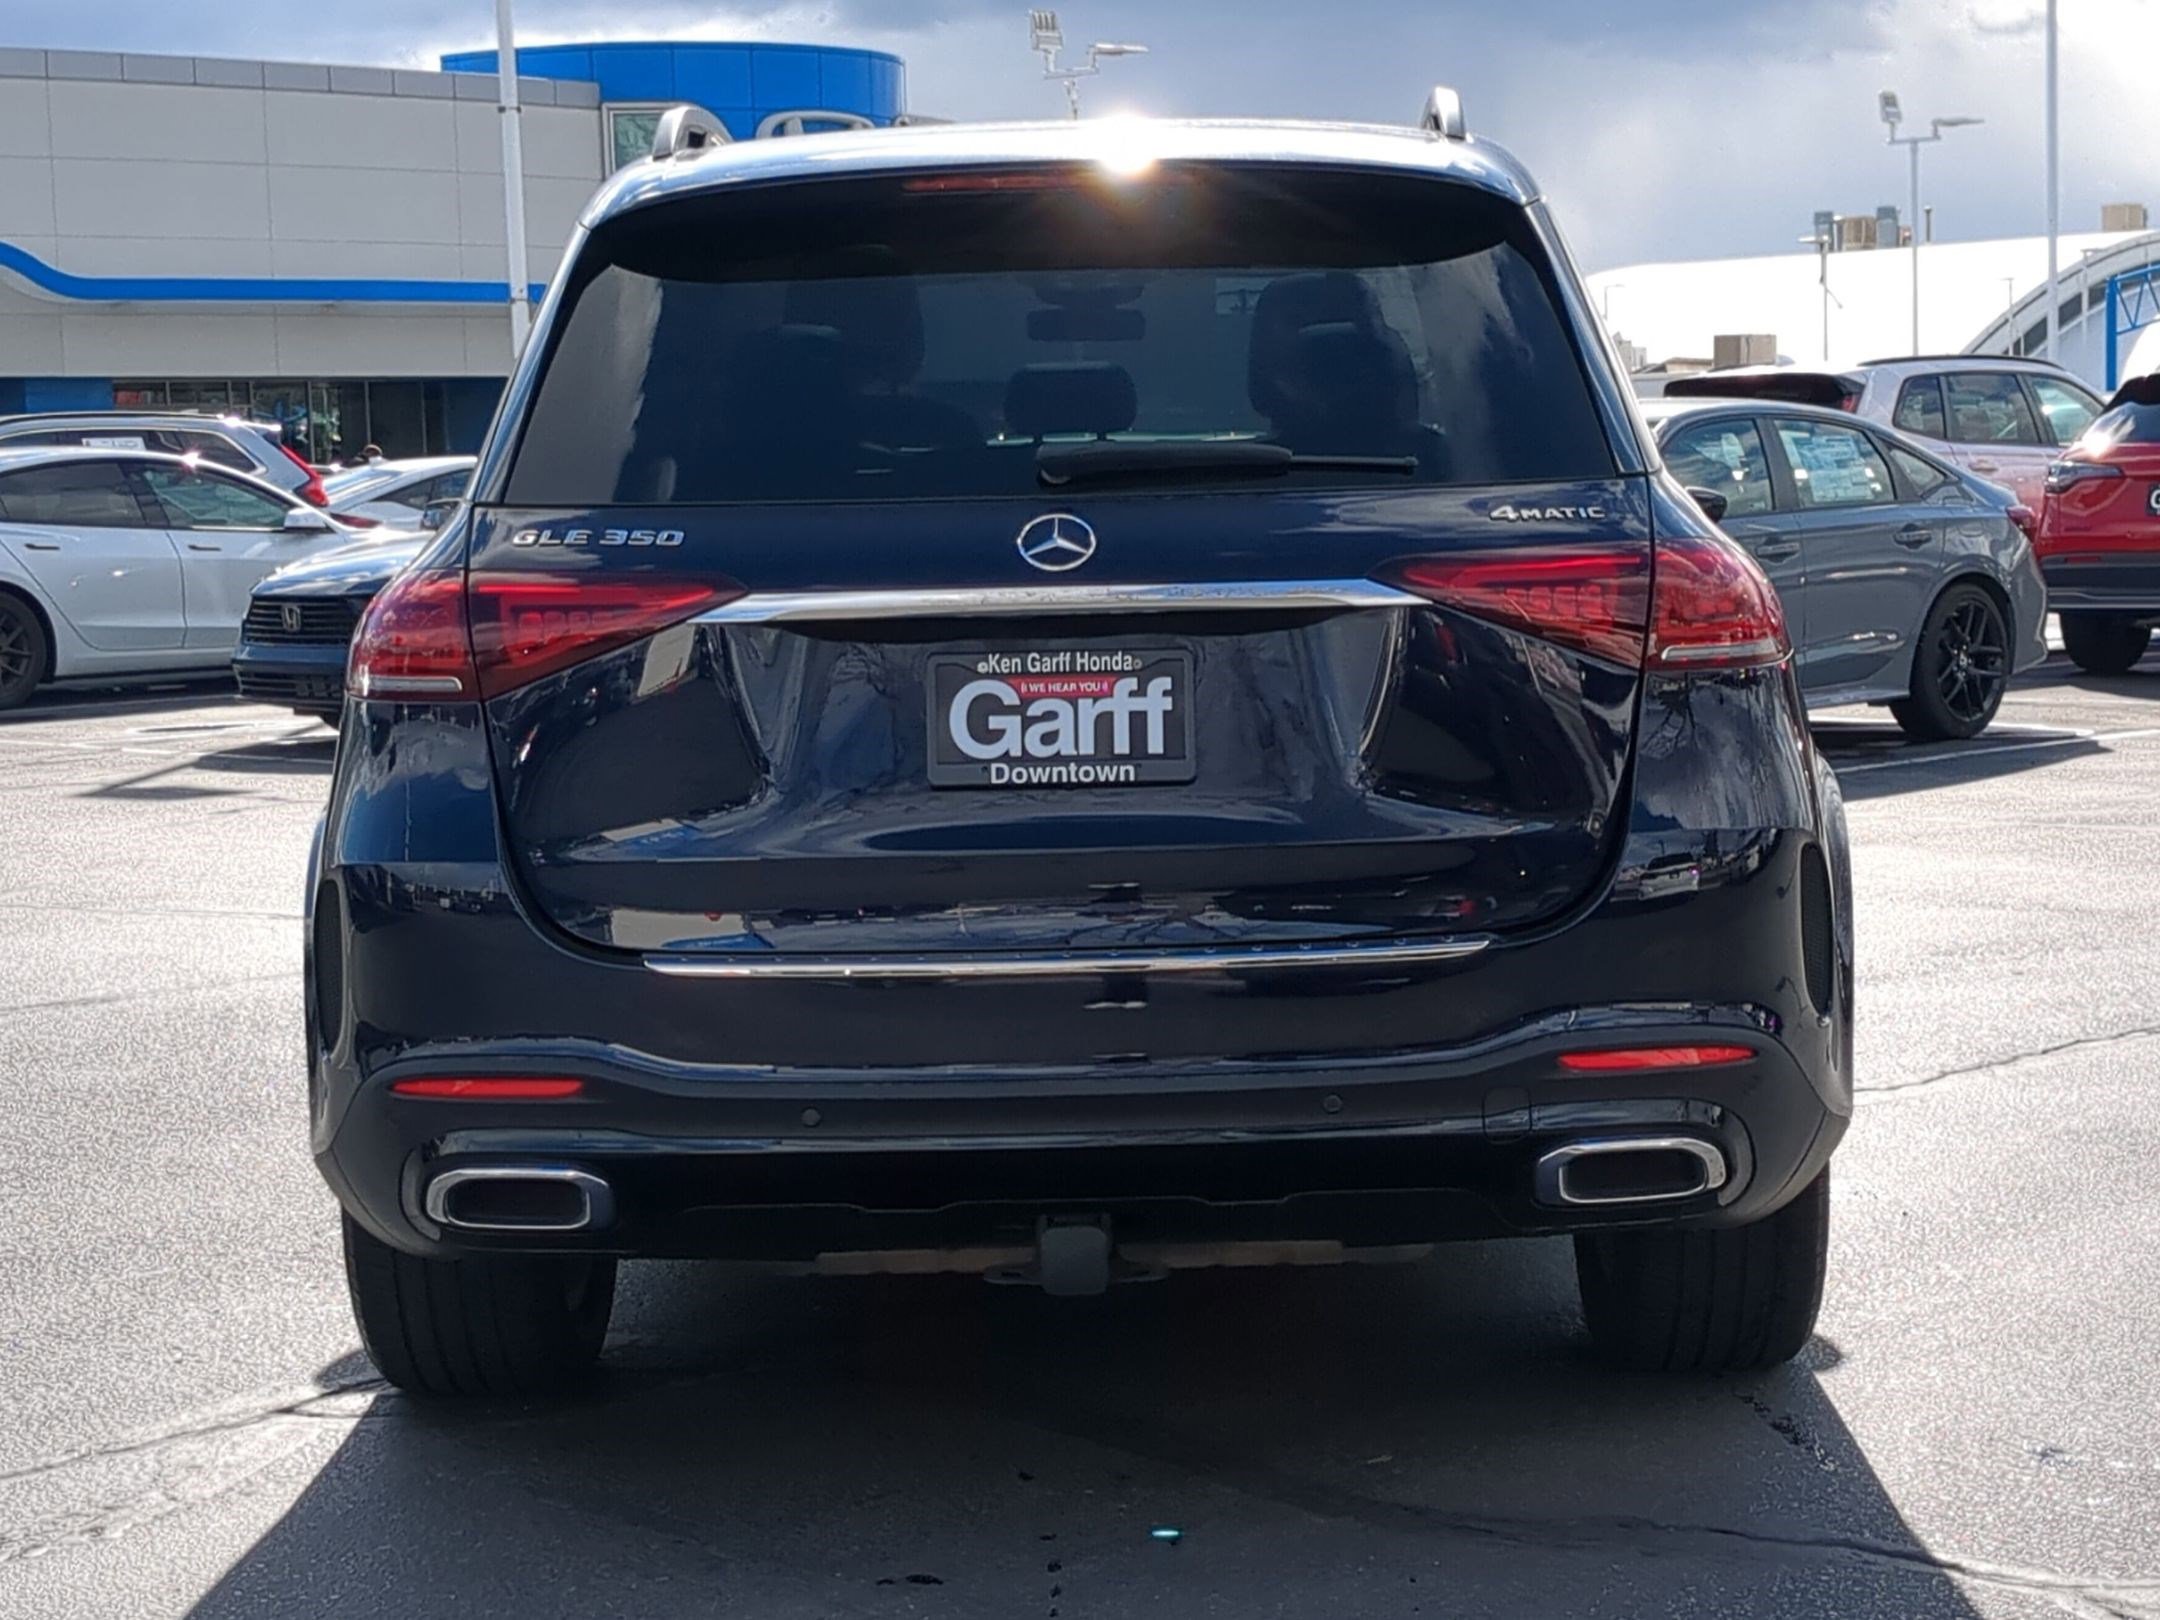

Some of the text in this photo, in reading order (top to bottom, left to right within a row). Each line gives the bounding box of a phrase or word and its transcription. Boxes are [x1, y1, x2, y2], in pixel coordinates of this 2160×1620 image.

[1490, 504, 1605, 520] 4MATIC
[512, 529, 685, 546] GLE 350
[988, 651, 1133, 674] Ken Garff Honda
[1028, 681, 1100, 693] WE HEAR YOU
[950, 676, 1173, 760] Garff
[990, 763, 1136, 785] Downtown
